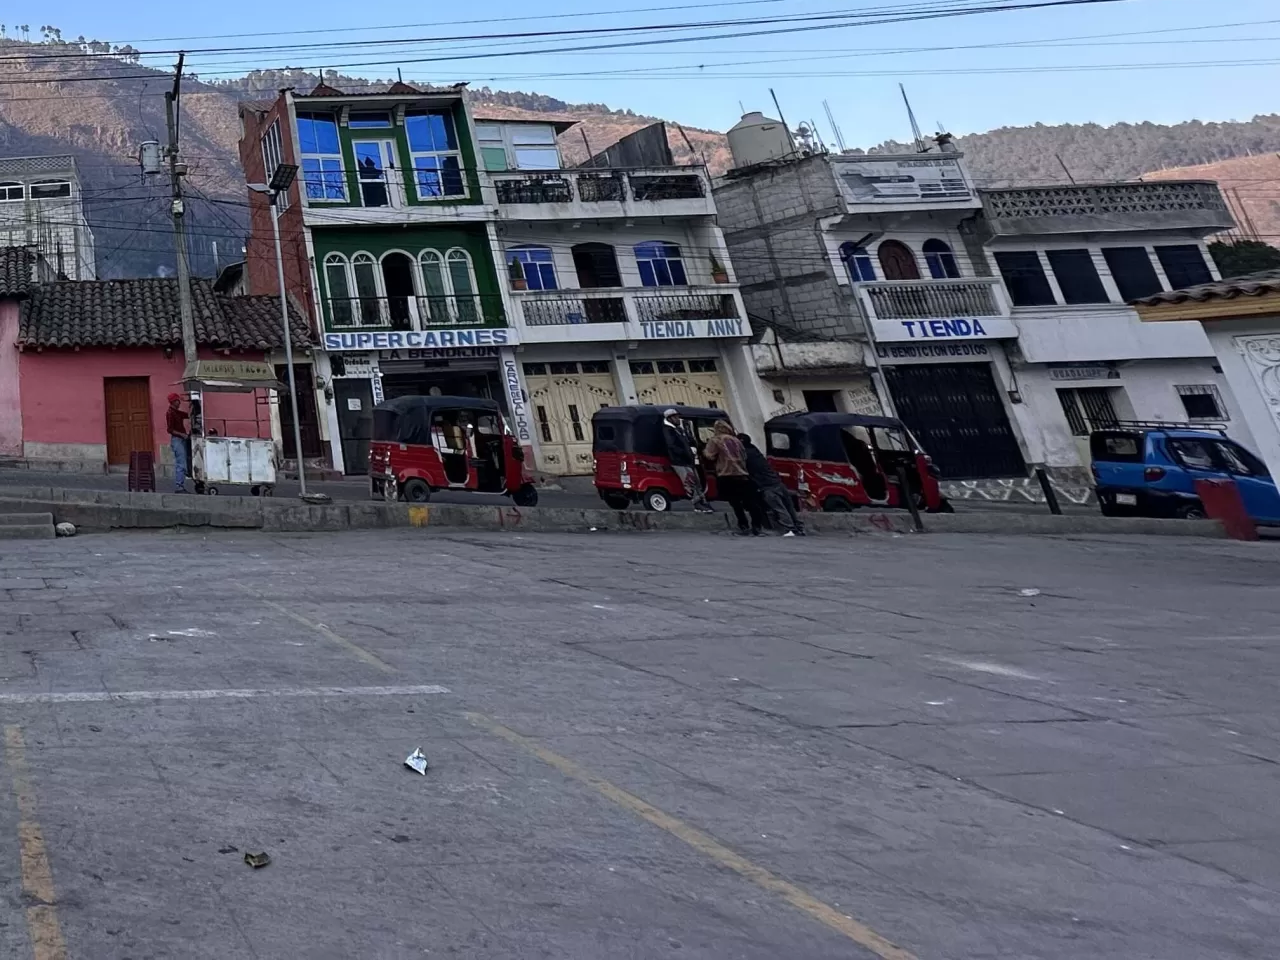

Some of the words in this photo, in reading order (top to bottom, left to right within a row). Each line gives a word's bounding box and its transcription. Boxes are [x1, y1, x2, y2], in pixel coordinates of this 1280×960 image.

[640, 321, 695, 338] TIENDA
[707, 317, 744, 336] ANNY
[901, 319, 987, 337] TIENDA
[326, 332, 404, 349] SUPER
[406, 329, 508, 347] CARNES
[379, 349, 401, 360] LA
[877, 347, 889, 358] LA
[890, 345, 947, 358] BENDICION
[948, 344, 963, 355] DE
[963, 343, 988, 355] DIOS
